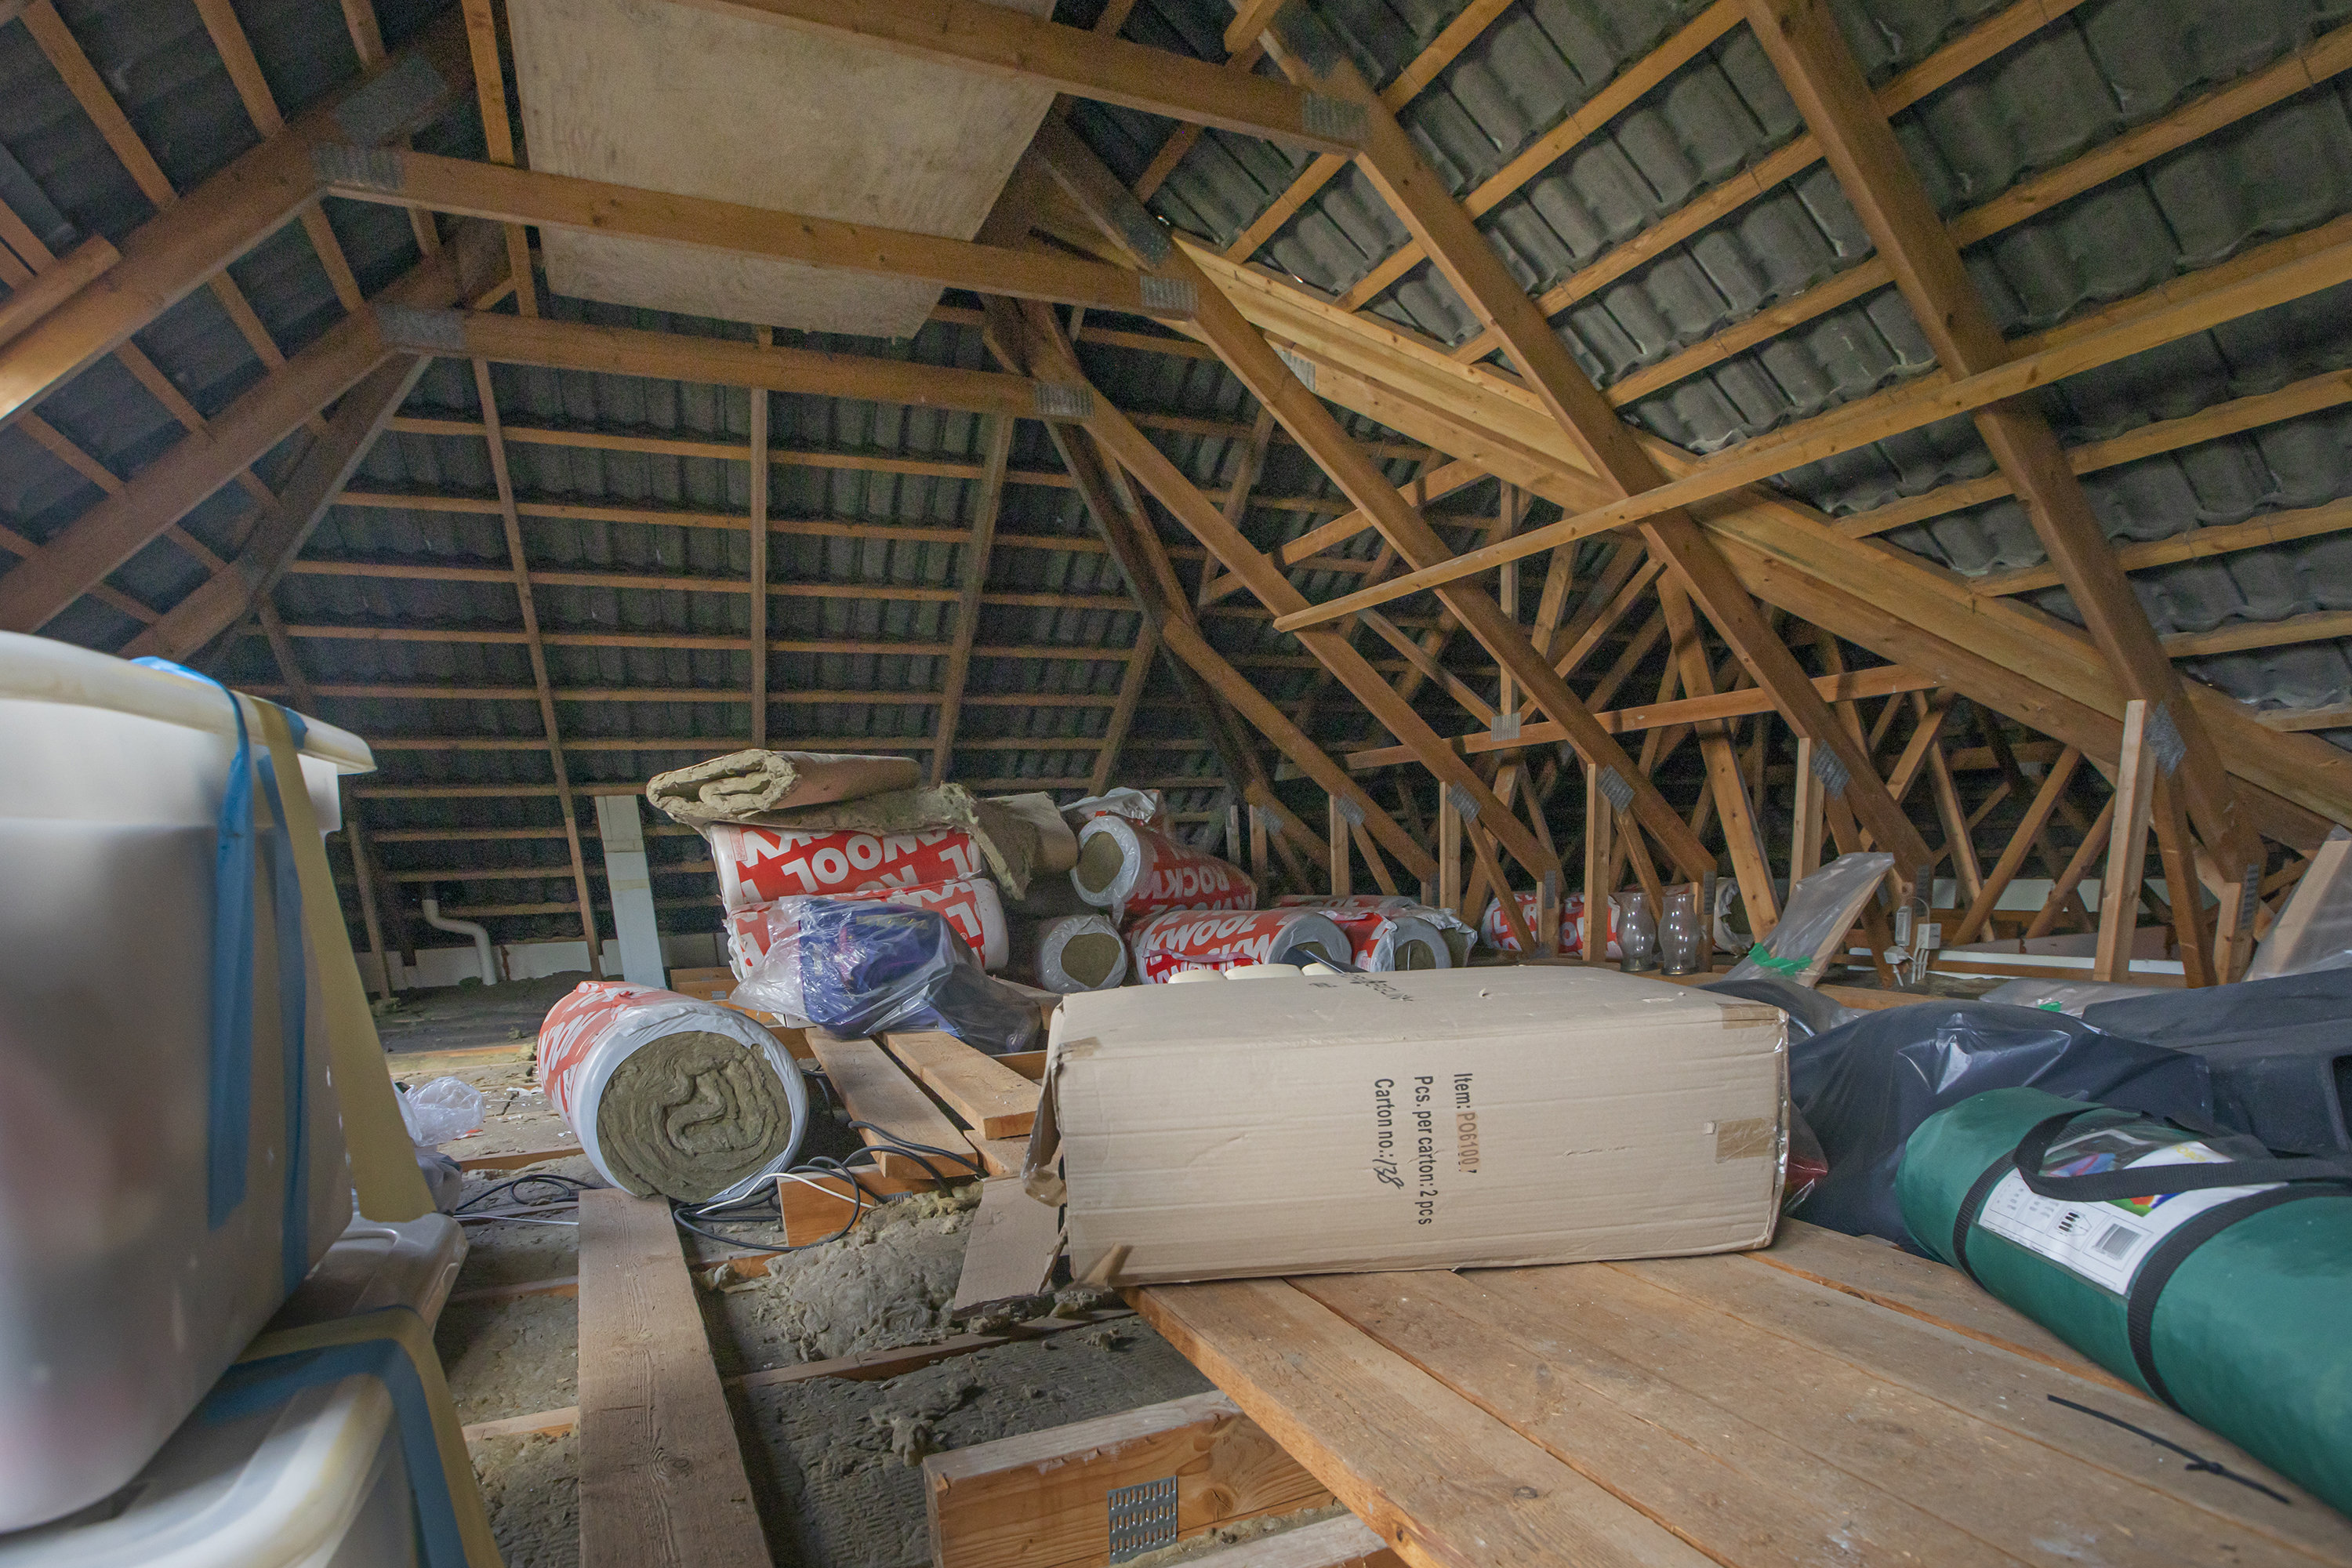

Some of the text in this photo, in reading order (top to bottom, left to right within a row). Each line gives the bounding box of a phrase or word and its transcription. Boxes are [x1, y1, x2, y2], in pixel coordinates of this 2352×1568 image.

[1374, 1078, 1396, 1127] Carton
[1414, 1076, 1434, 1107] Pcs.
[1454, 1073, 1473, 1109] Item:
[1412, 1110, 1432, 1134] per
[1417, 1137, 1437, 1186] carton:
[1414, 1200, 1434, 1225] pcs
